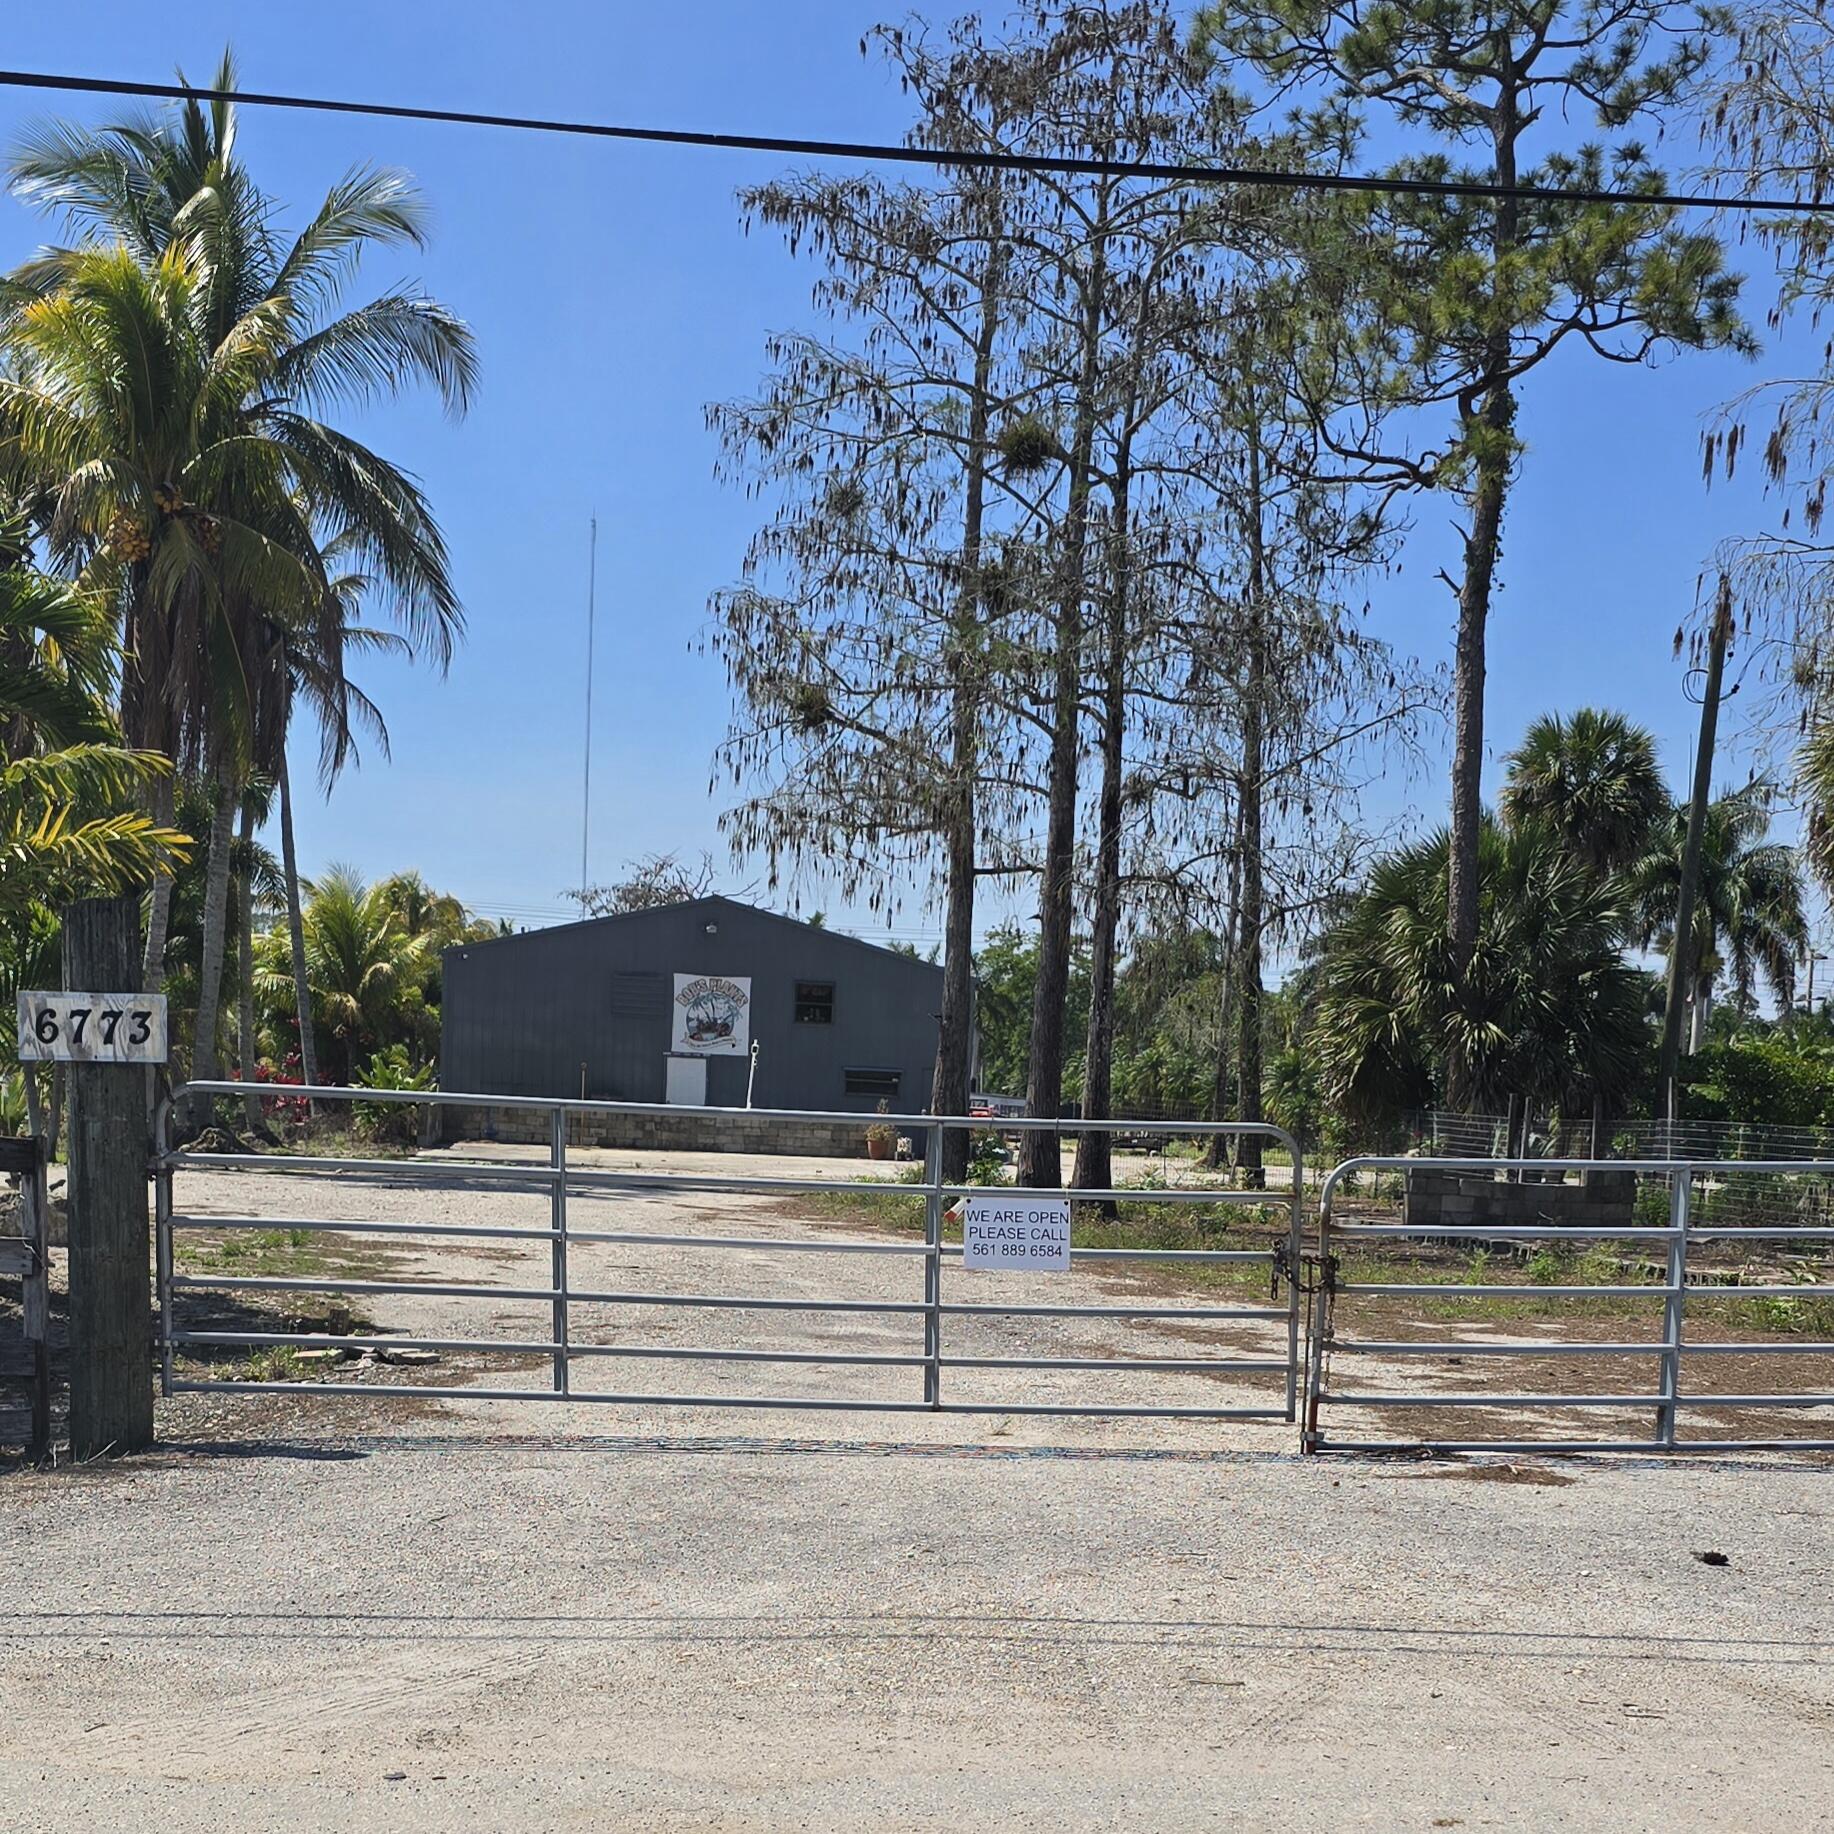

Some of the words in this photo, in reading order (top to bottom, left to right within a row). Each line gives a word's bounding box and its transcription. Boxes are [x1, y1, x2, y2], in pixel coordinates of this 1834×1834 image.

[675, 978, 708, 1007] BOB'S
[709, 977, 748, 1008] PLANTS
[35, 1008, 152, 1045] 6773
[966, 1210, 990, 1222] WE
[993, 1210, 1024, 1223] ARE
[1028, 1211, 1069, 1224] OPEN
[969, 1226, 1026, 1240] PLEASE
[1030, 1228, 1067, 1241] CALL
[972, 1243, 996, 1256] 561
[1001, 1244, 1026, 1256] 889
[1030, 1245, 1062, 1257] 6584
